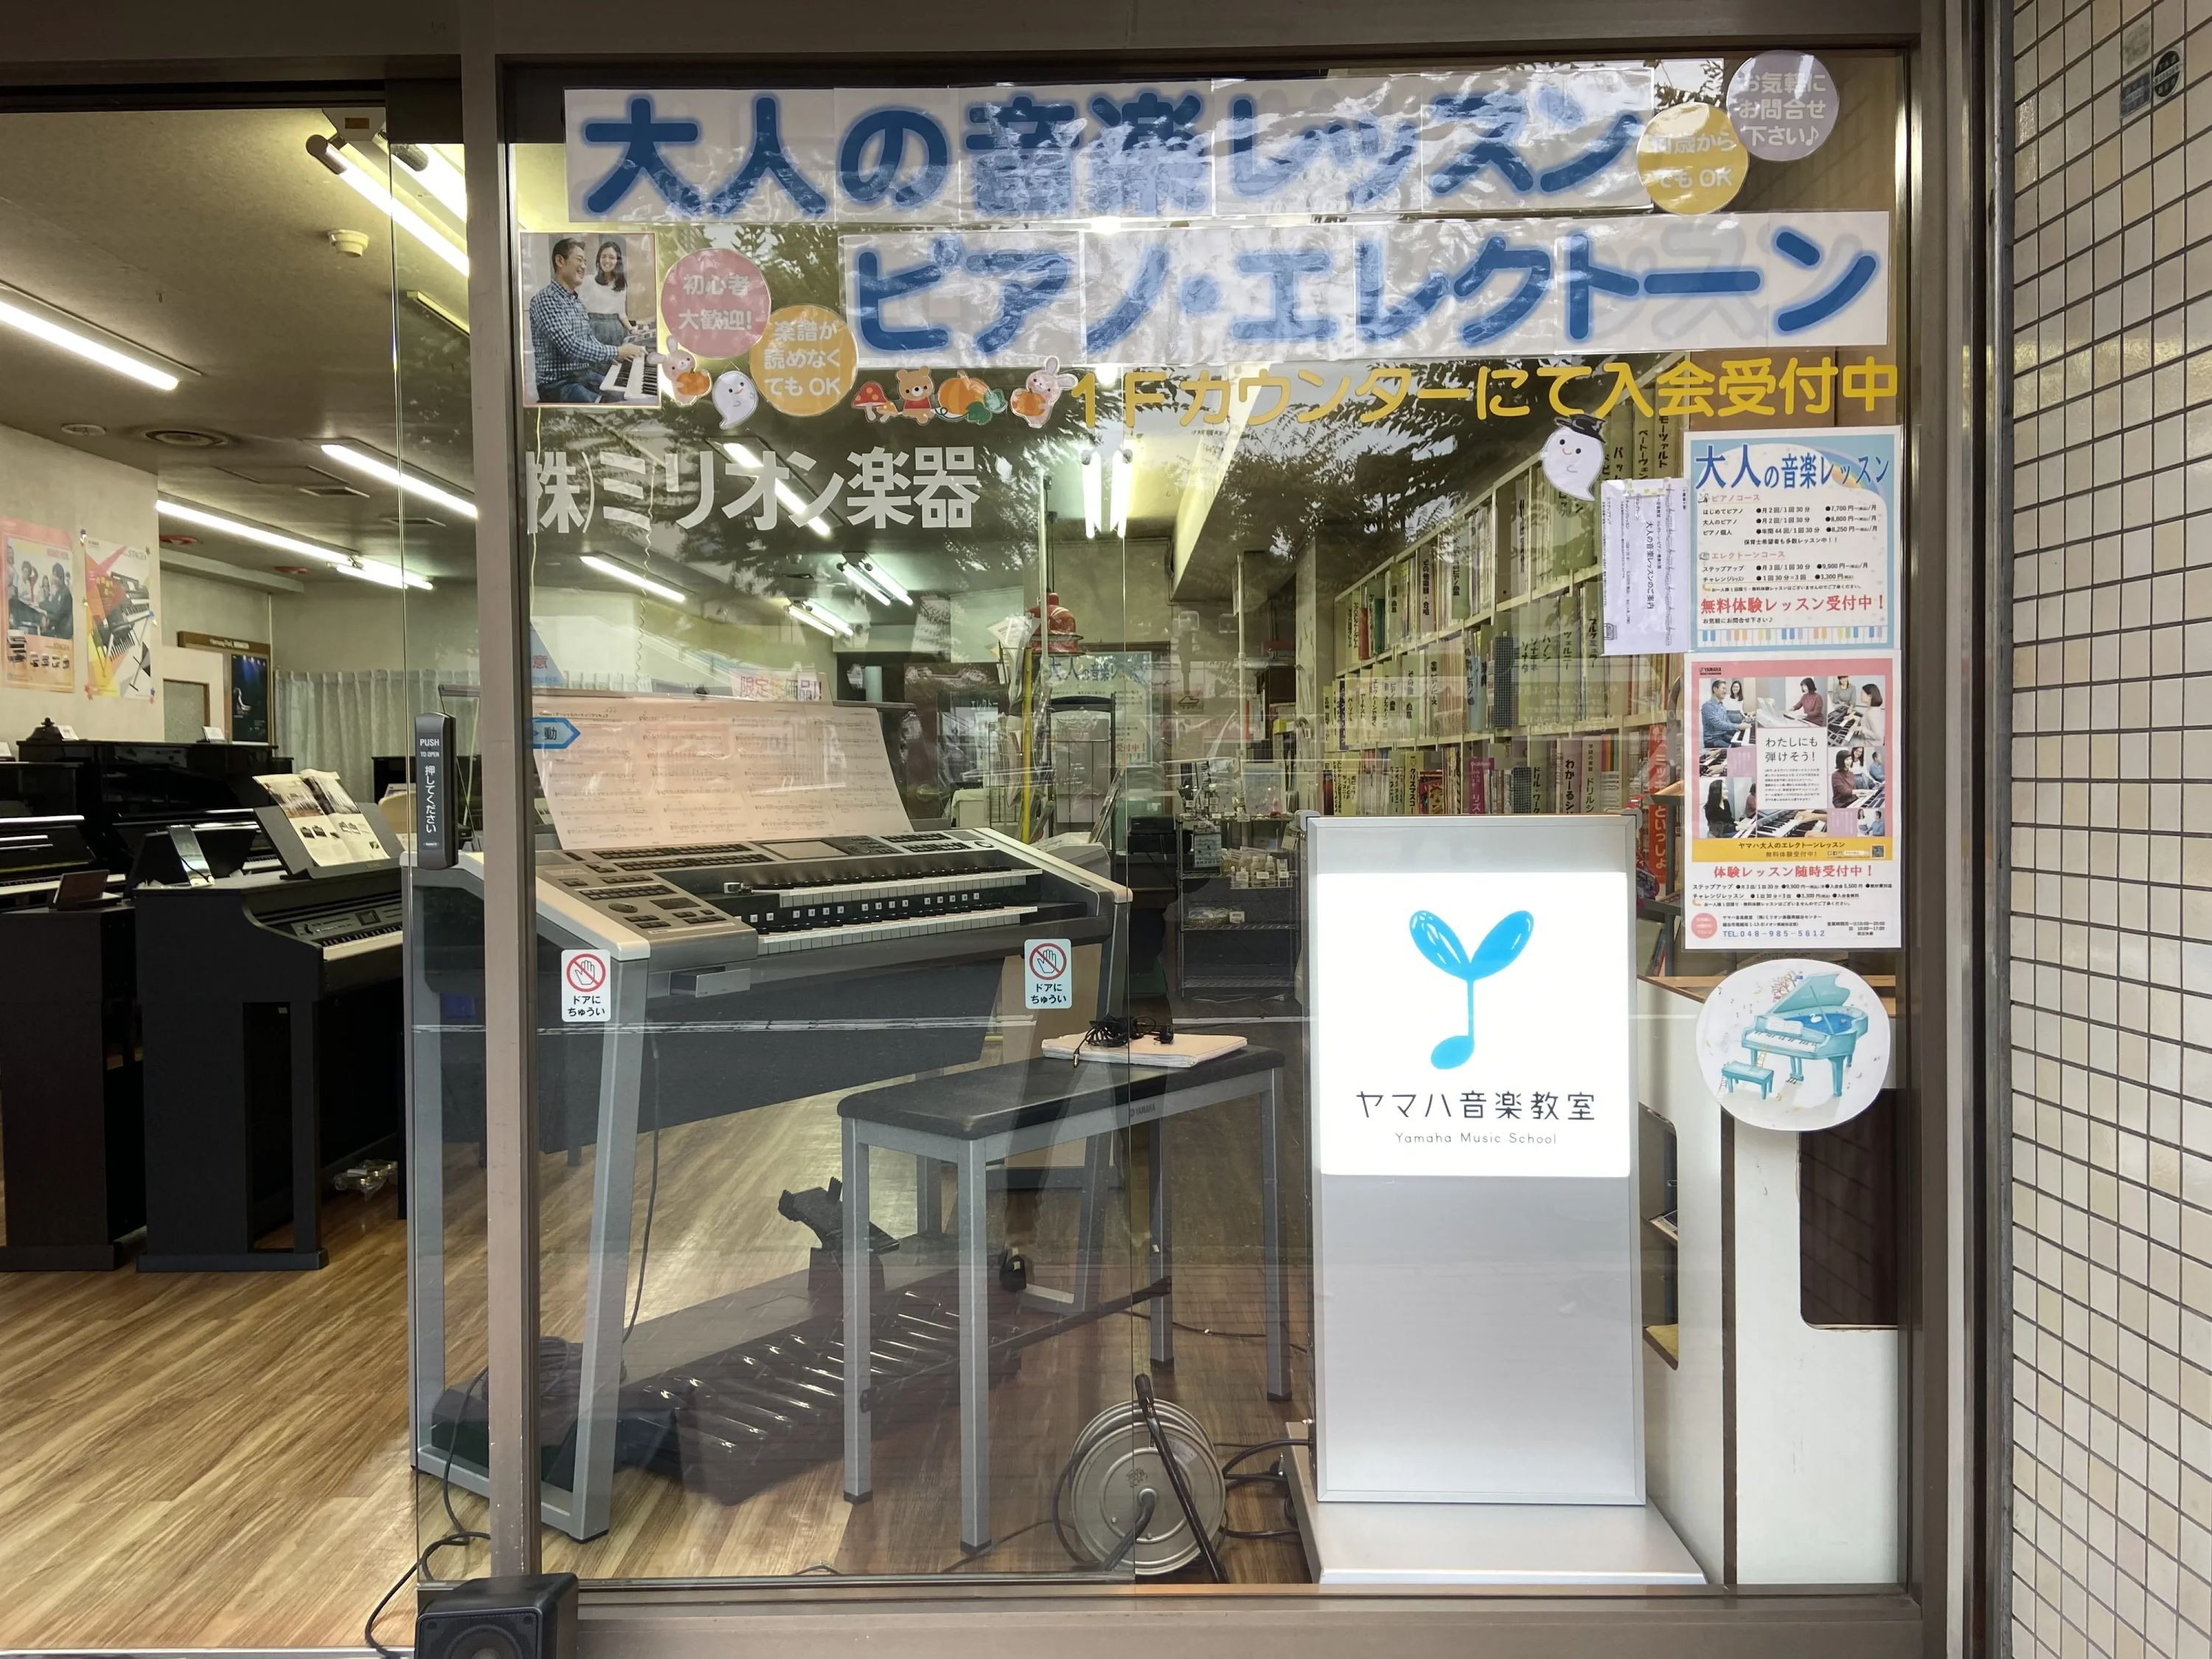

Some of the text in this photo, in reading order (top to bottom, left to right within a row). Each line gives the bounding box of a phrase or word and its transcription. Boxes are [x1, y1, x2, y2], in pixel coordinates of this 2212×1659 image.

[1739, 99, 1826, 119] お問合せ
[582, 90, 1638, 218] 大人の音楽レッスン
[683, 274, 751, 296] 初心者
[853, 225, 1877, 356] ピアノ・エレクトーン
[678, 309, 753, 331] 大歓迎!
[774, 320, 839, 343] 楽譜が
[763, 348, 841, 370] 読めなく
[809, 378, 842, 397] OK
[1695, 443, 1889, 490] 大人の音楽レッスン
[1700, 594, 1883, 615] 無料体験レッスン受付中！
[420, 738, 440, 747] PUSH
[543, 726, 557, 740] 動
[1765, 737, 1818, 748] わたしにも
[1764, 751, 1816, 763] 弾けそう！
[424, 765, 437, 833] 押してください
[1738, 841, 1846, 849] ヤマハ大人のエレクトーンレッスン
[1713, 865, 1872, 879] 体験レッスン随時受付中！
[1035, 982, 1062, 993] ドアに
[572, 995, 600, 1006] ドアに
[1031, 993, 1067, 1005] ちゅうい
[567, 1006, 605, 1018] ちゅうい
[1356, 1089, 1596, 1121] ヤマハ音楽教室
[1395, 1132, 1557, 1144] Yamaha Music School
